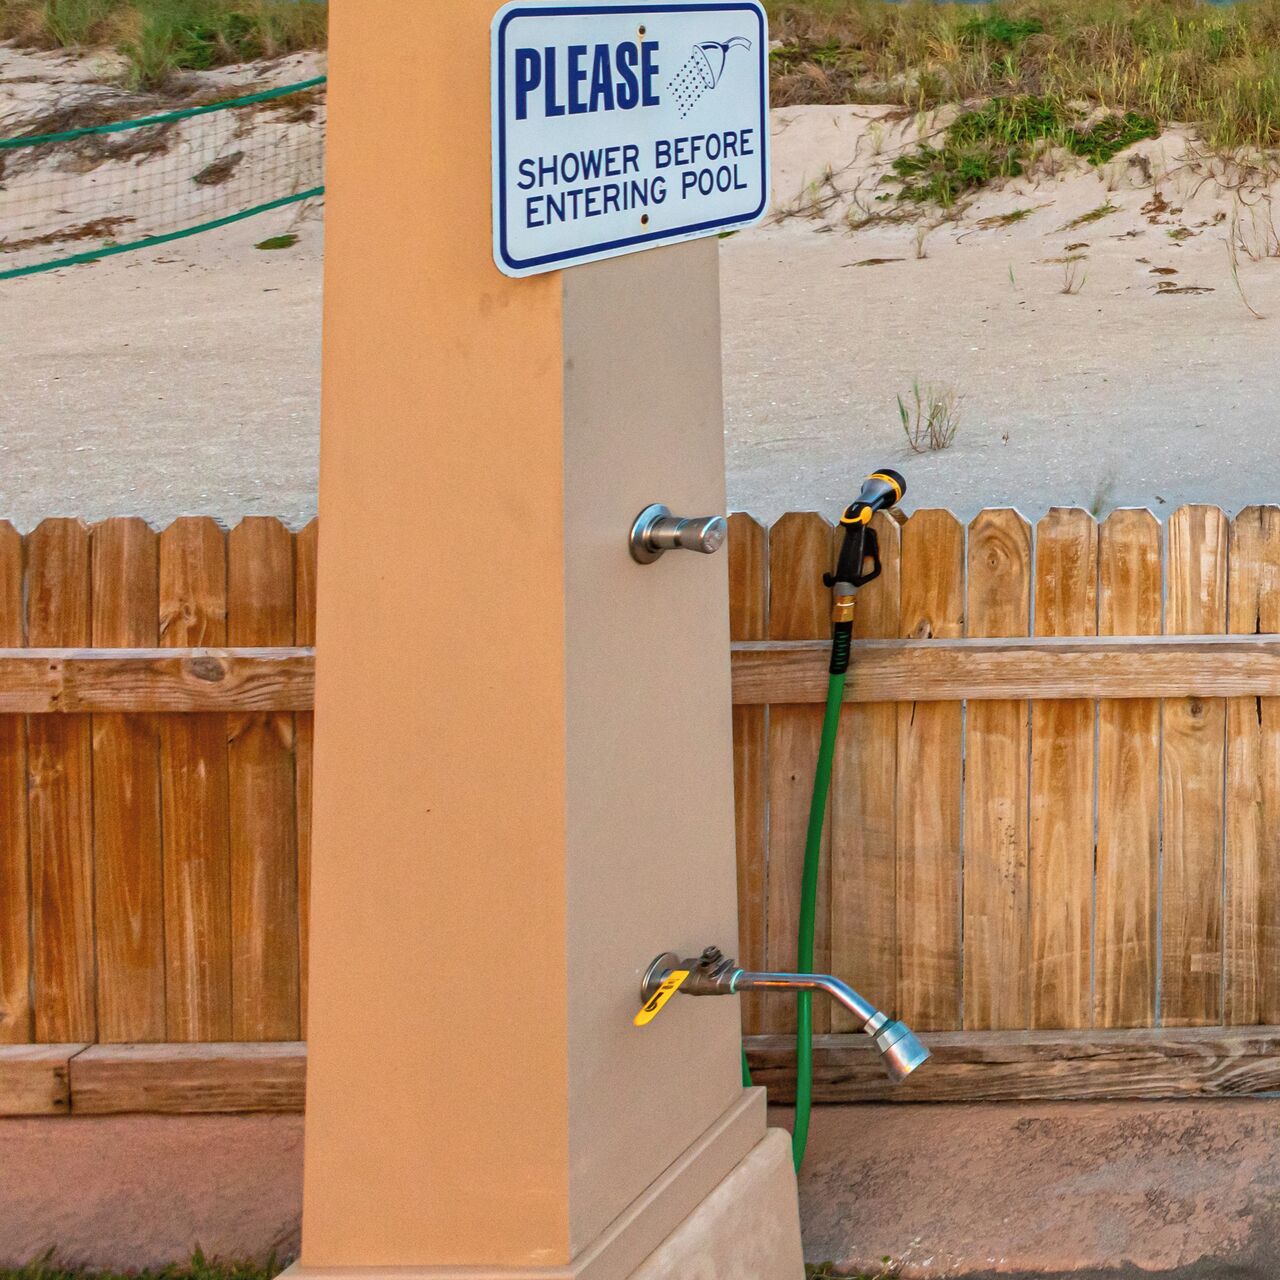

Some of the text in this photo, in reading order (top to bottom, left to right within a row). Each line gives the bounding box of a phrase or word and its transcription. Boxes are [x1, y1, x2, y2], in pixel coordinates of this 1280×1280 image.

[515, 41, 660, 121] PLEASE
[517, 128, 754, 190] SHOWER BEFORE
[527, 164, 748, 229] ENTERING POOL
